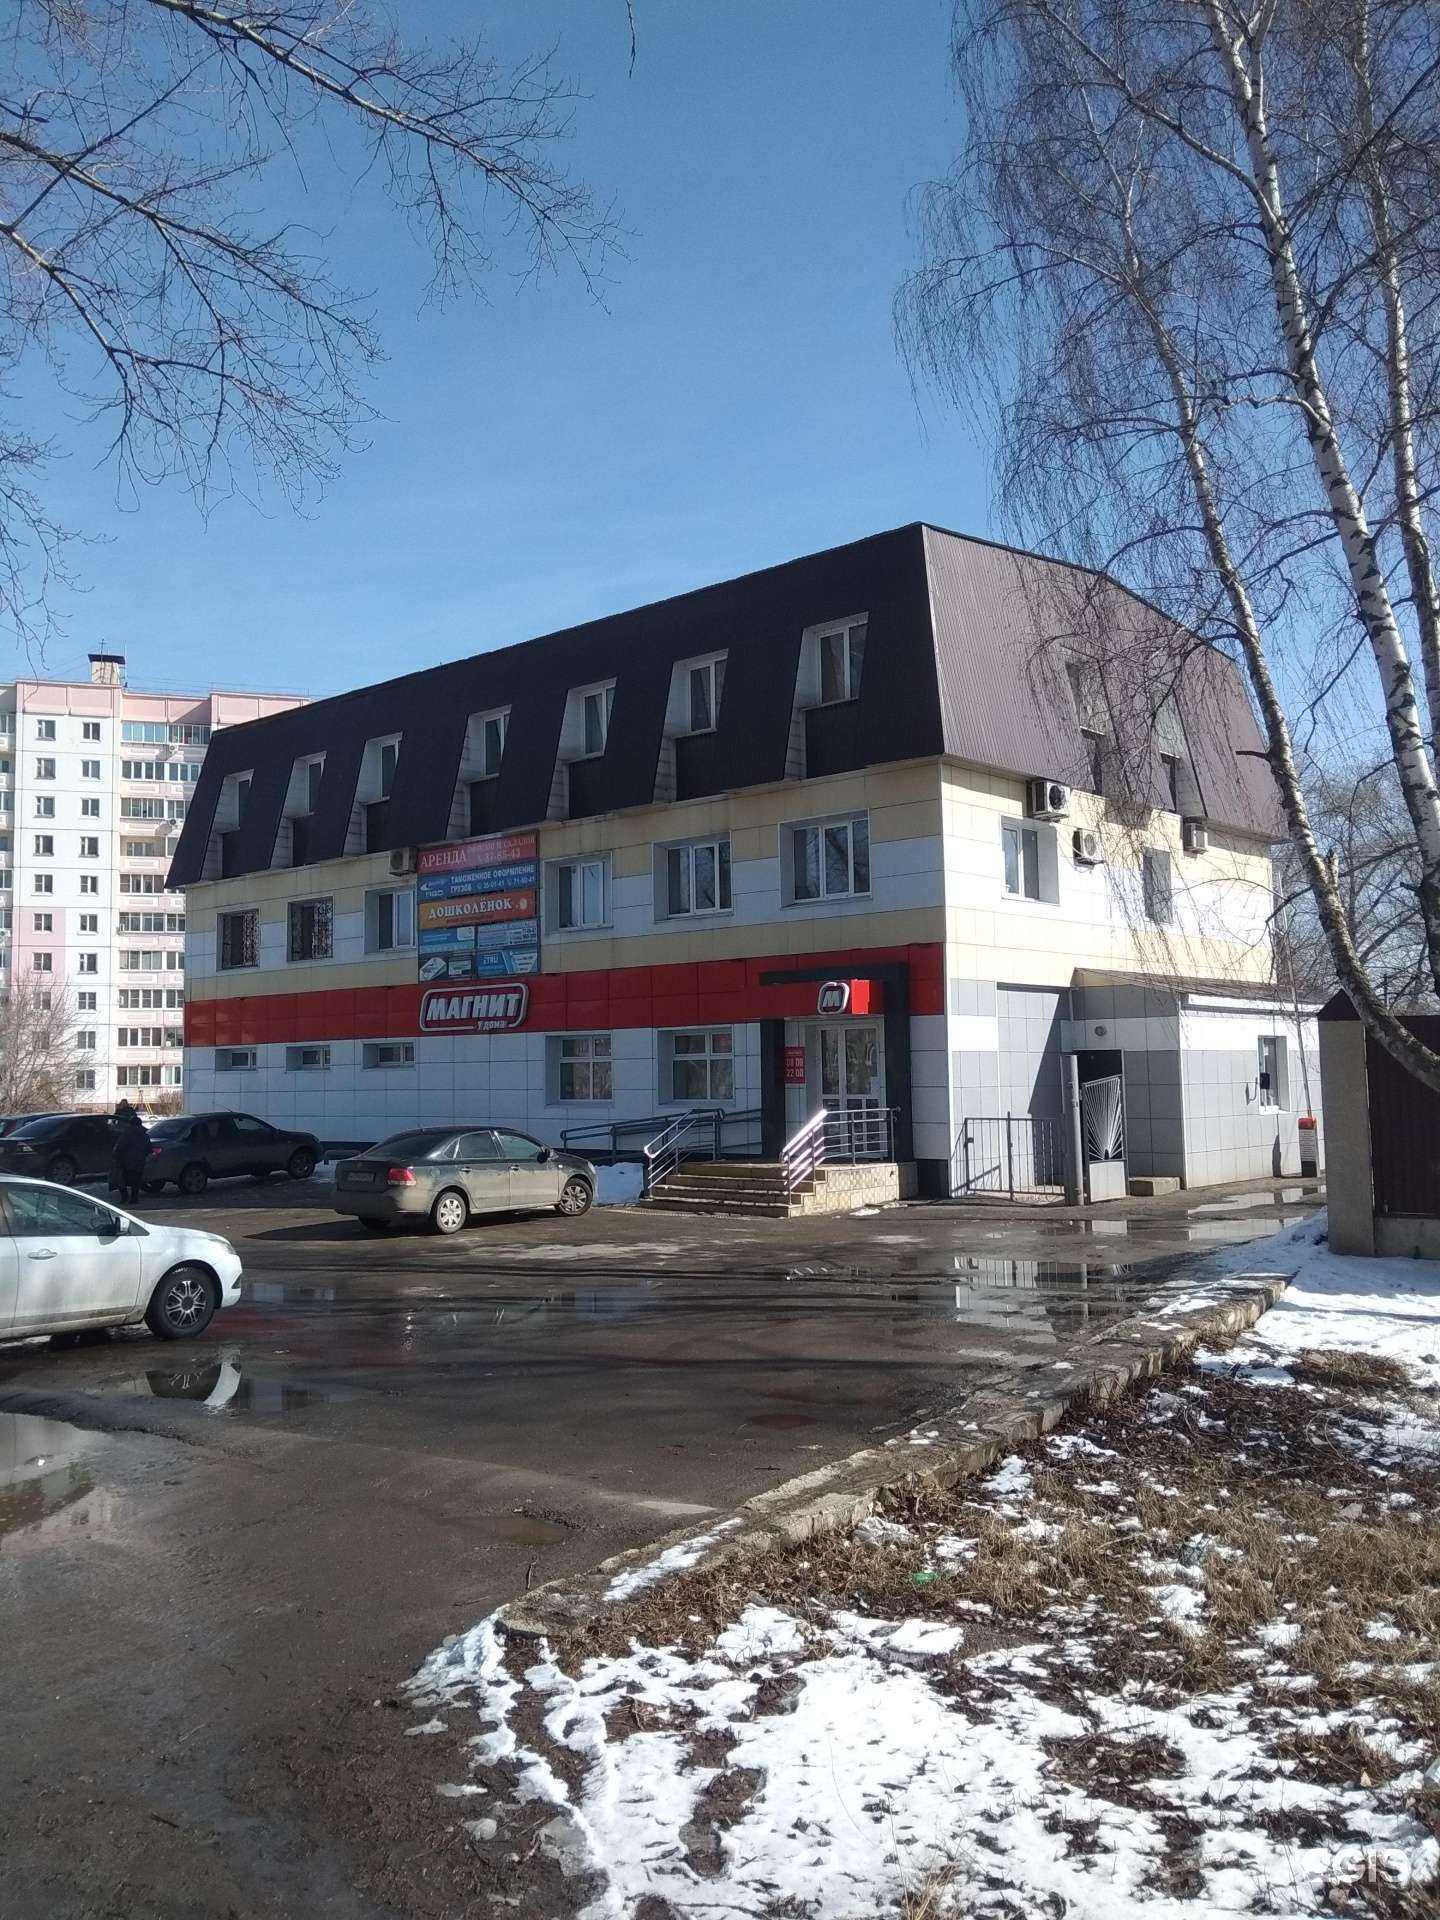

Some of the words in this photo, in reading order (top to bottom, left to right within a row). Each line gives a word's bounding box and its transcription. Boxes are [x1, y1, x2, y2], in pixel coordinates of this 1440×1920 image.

[421, 849, 467, 868] АРЕНДА
[451, 871, 492, 883] ТАМОЖЕННОЕ
[493, 864, 535, 878] ОФОРМЛЕНИЕ
[428, 896, 512, 919] ДОШКОЛЁНОК
[426, 993, 521, 1021] МАГНИТ
